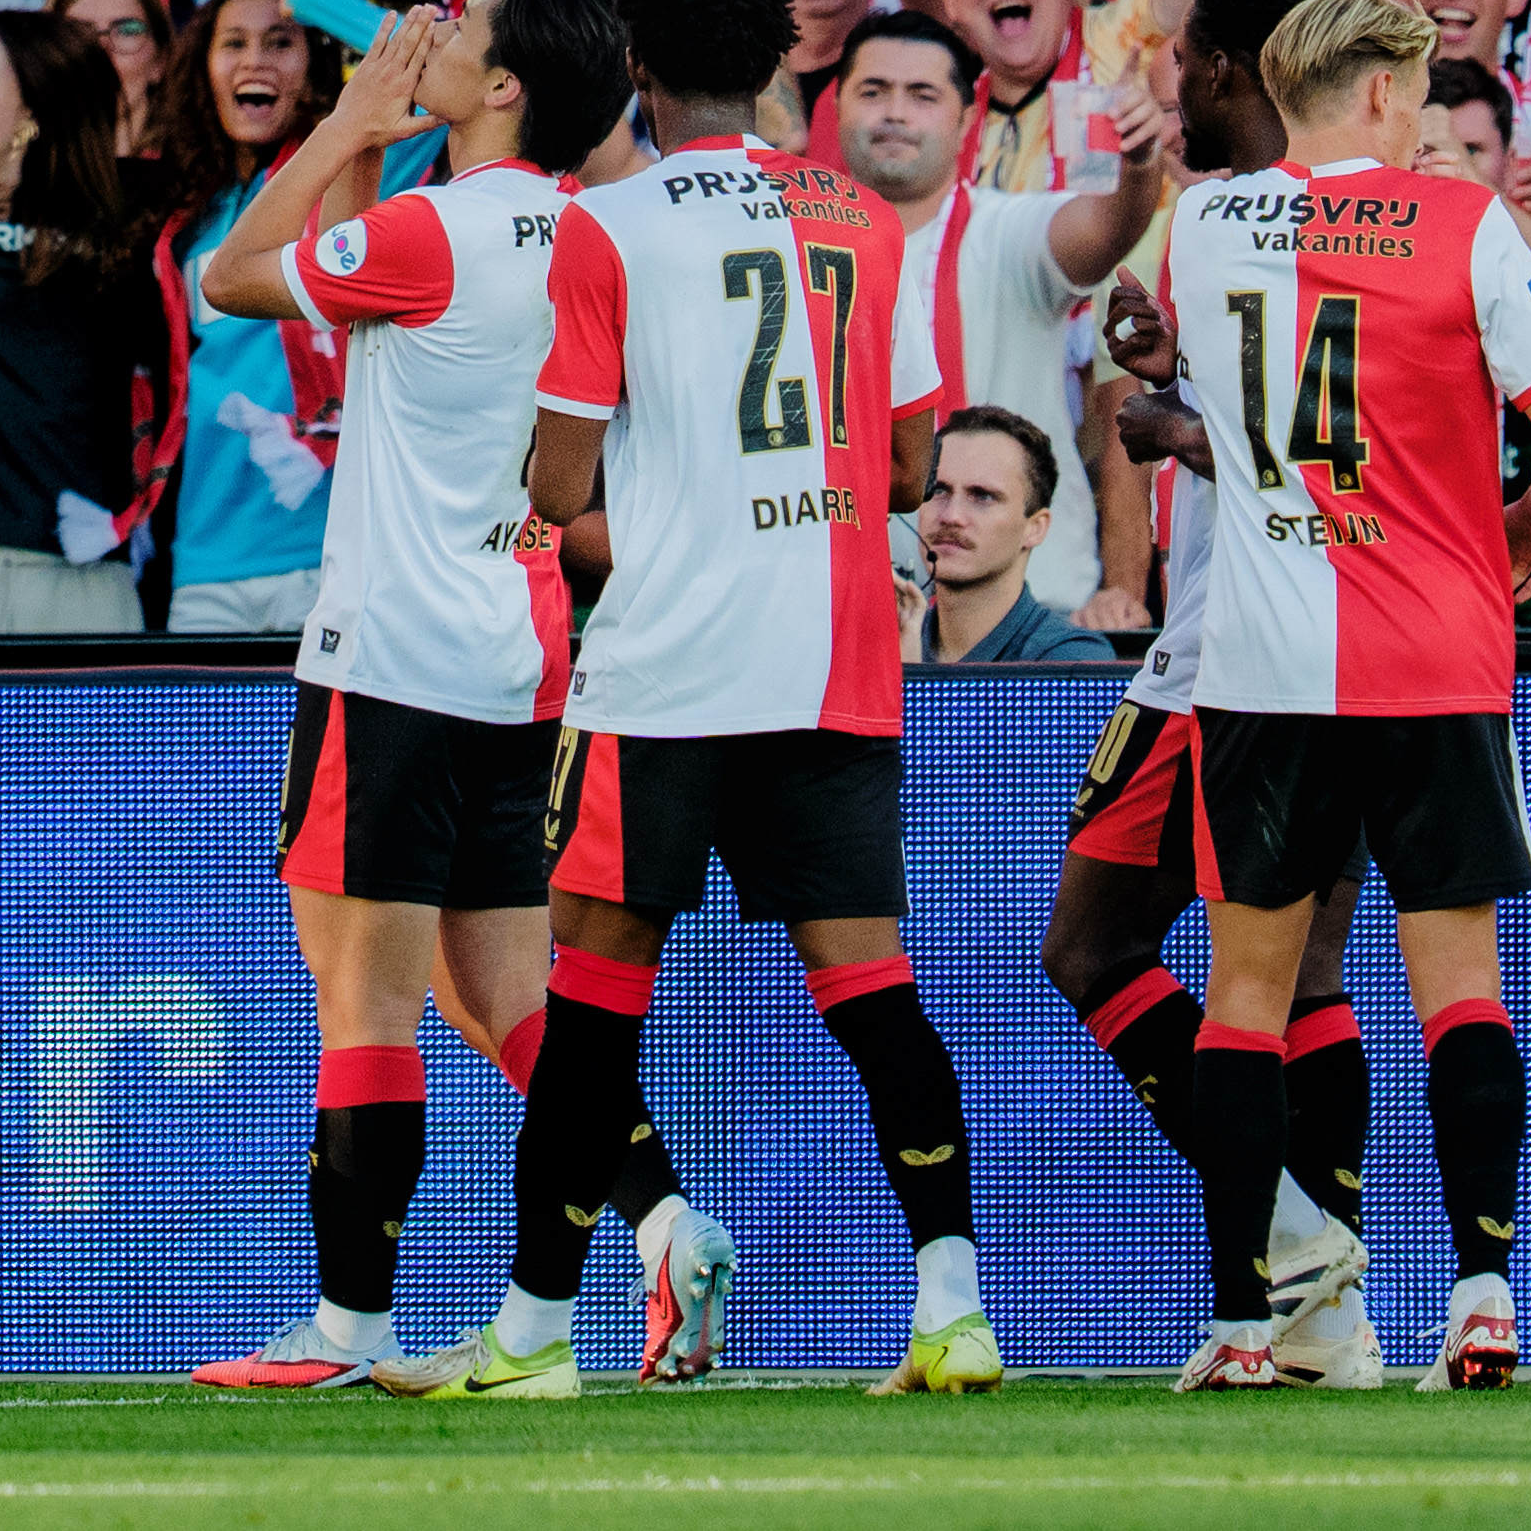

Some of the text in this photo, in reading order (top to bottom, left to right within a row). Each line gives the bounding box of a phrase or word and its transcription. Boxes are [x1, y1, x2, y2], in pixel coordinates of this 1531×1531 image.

[740, 194, 872, 231] vakanties
[1251, 225, 1416, 260] vakanties
[721, 241, 858, 457] 27
[1225, 289, 1371, 495] 14
[751, 486, 863, 531] DIARR
[479, 516, 554, 553] AYASE
[1265, 510, 1388, 548] STEIJN
